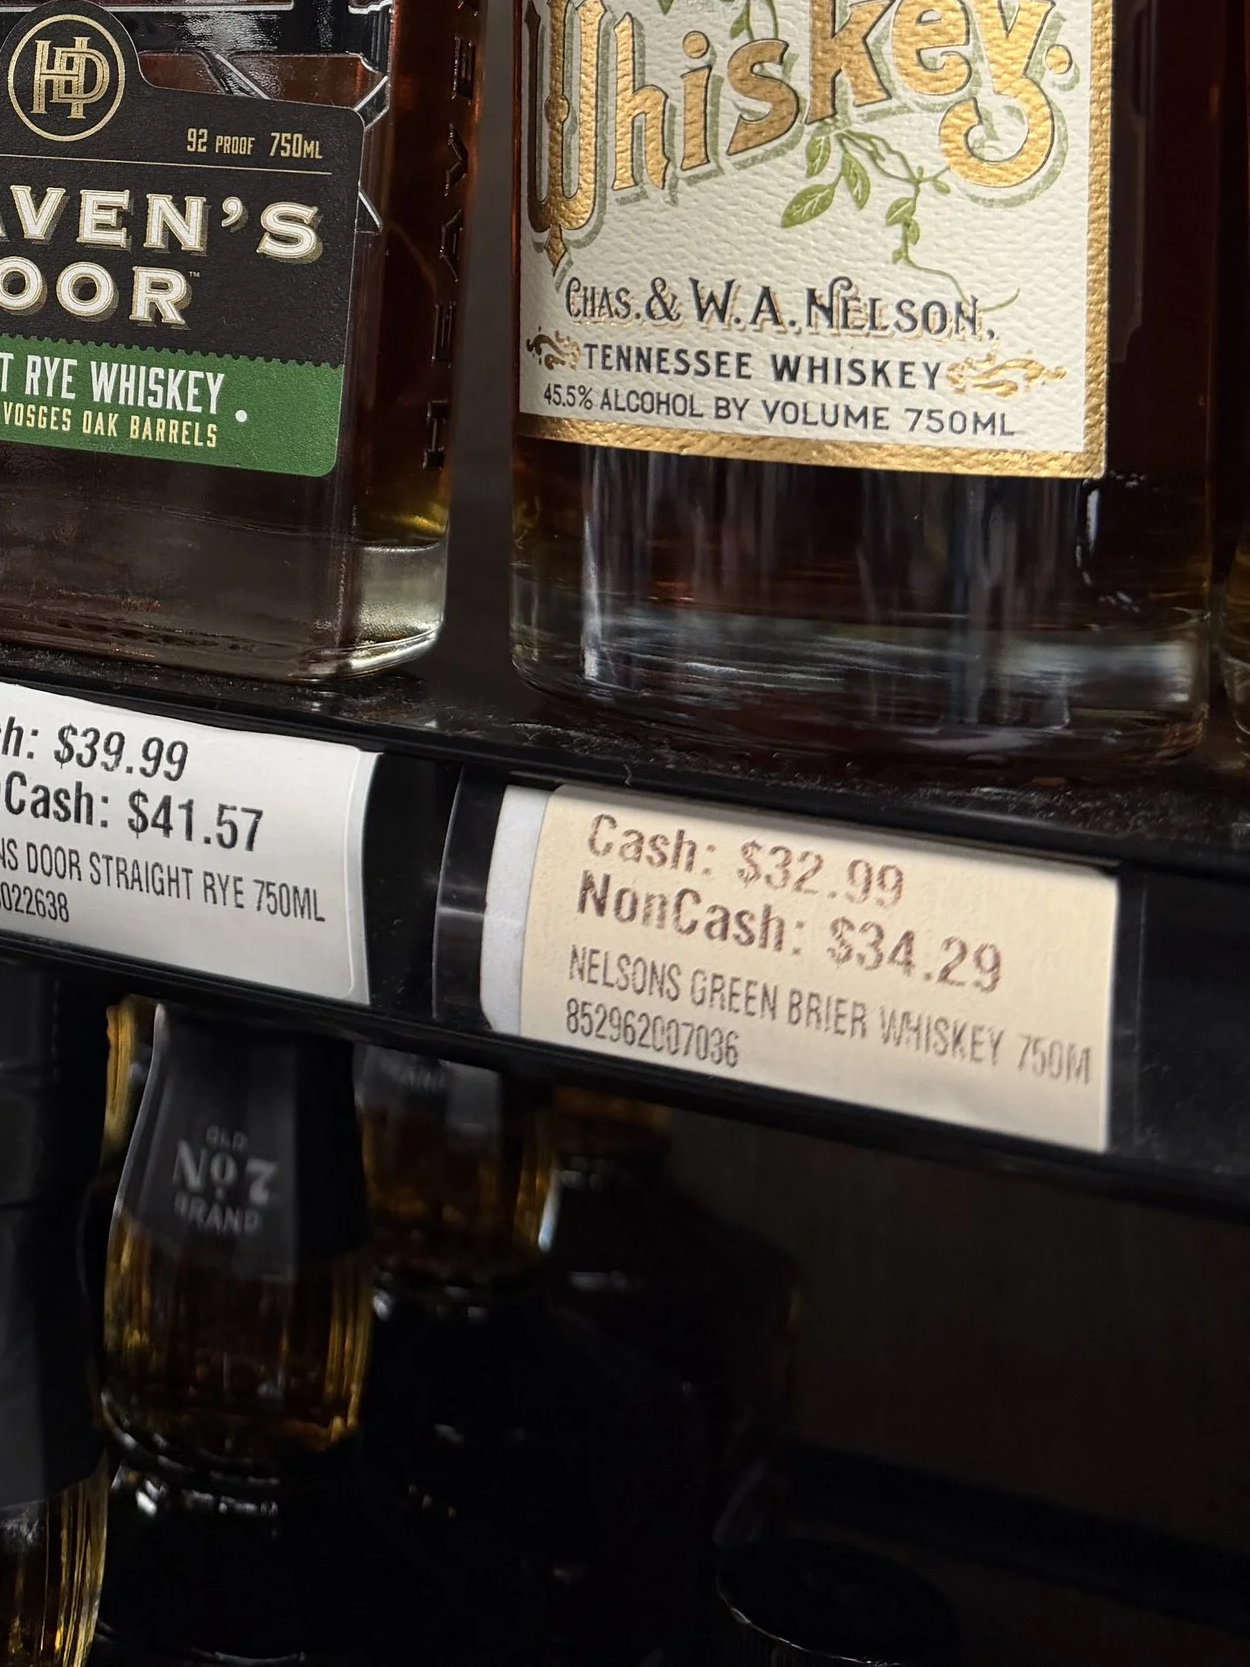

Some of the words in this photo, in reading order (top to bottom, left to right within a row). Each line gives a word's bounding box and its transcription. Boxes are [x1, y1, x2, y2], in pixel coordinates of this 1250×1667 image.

[187, 128, 208, 153] 92
[215, 135, 256, 156] PROOF
[269, 132, 323, 160] 750ML
[26, 356, 78, 398] RYE
[90, 360, 226, 415] WHISKEY
[583, 343, 753, 381] TENNESSEE
[770, 355, 942, 391] WHISKEY
[2, 400, 72, 432] VOSGES
[82, 408, 119, 439] OAK
[129, 415, 219, 449] BARRELS
[543, 384, 594, 411] 45.5%
[600, 387, 704, 420] ALCOHOL
[713, 398, 749, 423] BY
[761, 400, 890, 432] VOLUME
[905, 406, 1017, 438] 750ML
[53, 722, 190, 783] $39.99
[127, 787, 265, 853] $41.57
[26, 841, 83, 883] DOOR
[89, 852, 194, 903] STRAIGHT
[202, 870, 246, 911] RYE
[253, 878, 327, 924] 750ML
[587, 813, 718, 878] Cash:
[737, 838, 906, 909] $32.99
[577, 869, 807, 957] NonCash:
[828, 914, 1003, 994] $34.29
[566, 997, 740, 1070] 852962007036
[568, 943, 683, 1005] NELSONS
[690, 965, 779, 1024] GREEN
[786, 986, 869, 1041] BRIER
[879, 1004, 1006, 1068] WHISKEY
